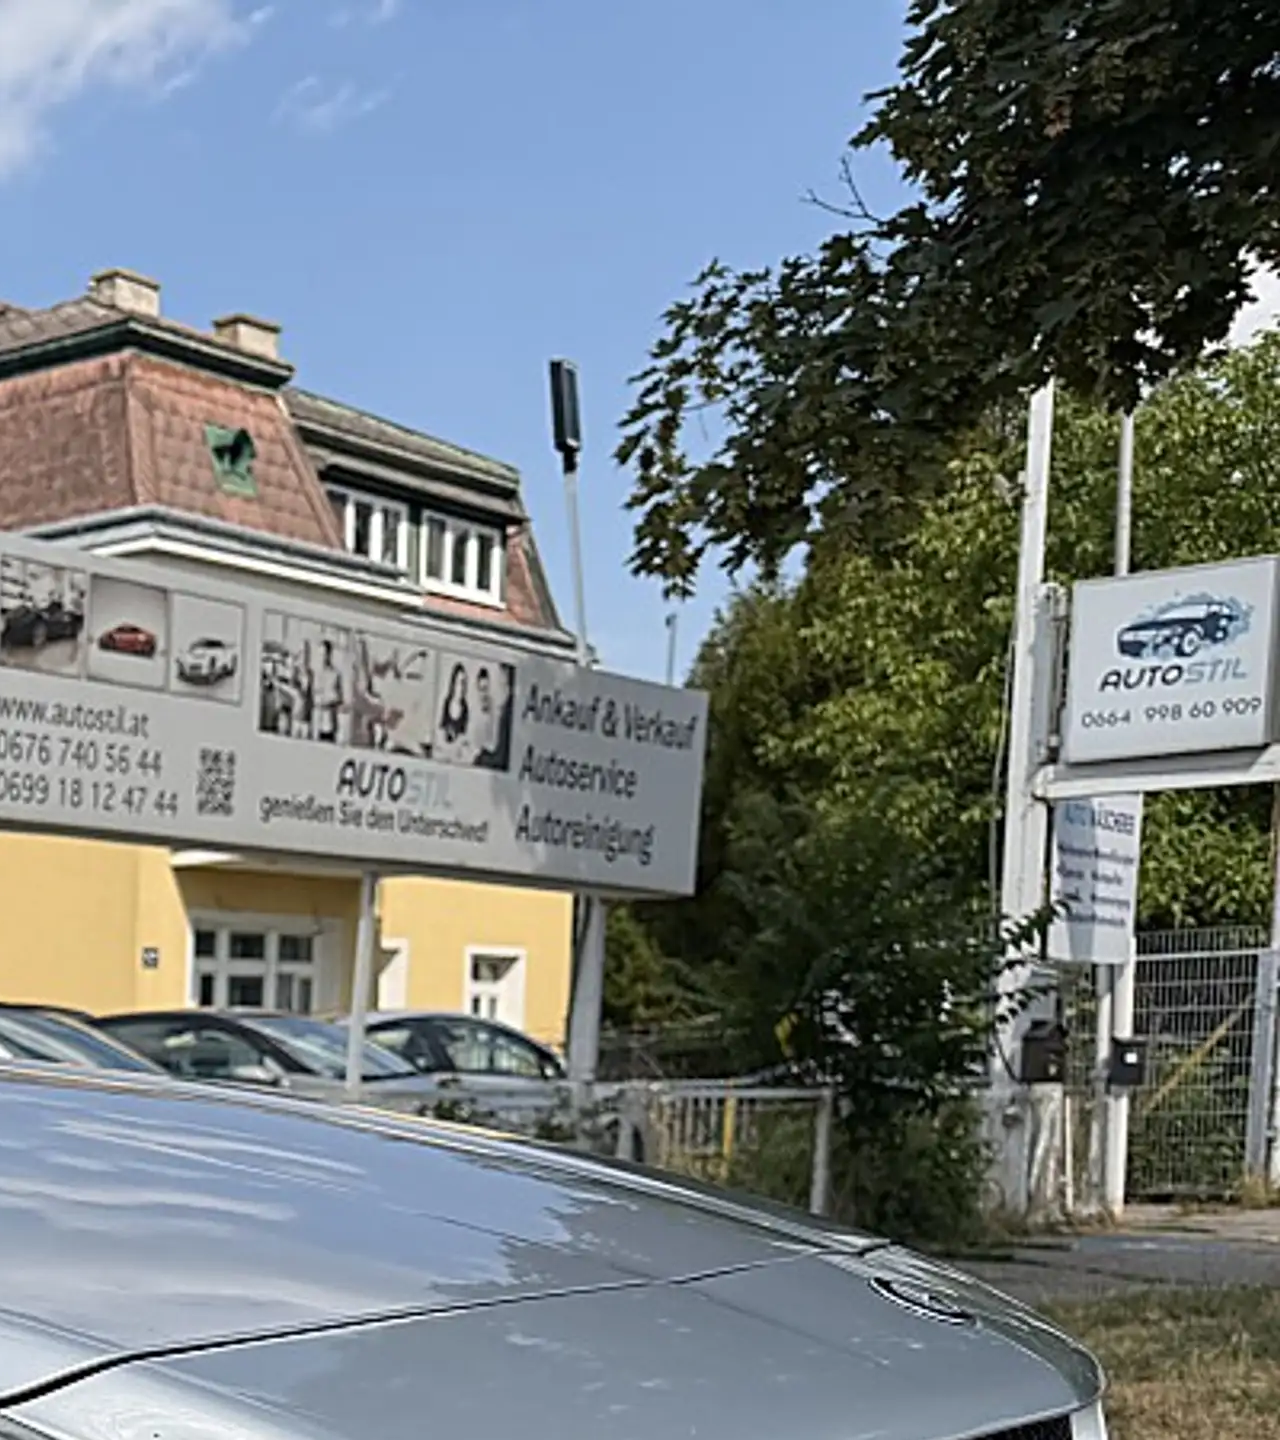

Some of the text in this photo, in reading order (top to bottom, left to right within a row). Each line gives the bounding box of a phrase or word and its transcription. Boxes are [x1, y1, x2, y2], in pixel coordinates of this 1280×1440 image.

[1099, 658, 1247, 692] AUTOSTIL
[522, 684, 699, 750] Ankauf & Verkauf
[1081, 697, 1262, 728] 0664 998 60 909
[58, 736, 99, 771] 740
[105, 743, 130, 775] 56
[136, 748, 162, 778] 44
[519, 744, 637, 798] Autoservice
[58, 777, 83, 809] 18
[92, 781, 116, 812] 12
[121, 785, 147, 814] 47
[153, 789, 178, 818] 44
[337, 758, 452, 809] AUTOSTIL
[259, 795, 334, 823] genießen
[339, 801, 363, 827] Sie
[516, 804, 655, 866] Autoreinigung
